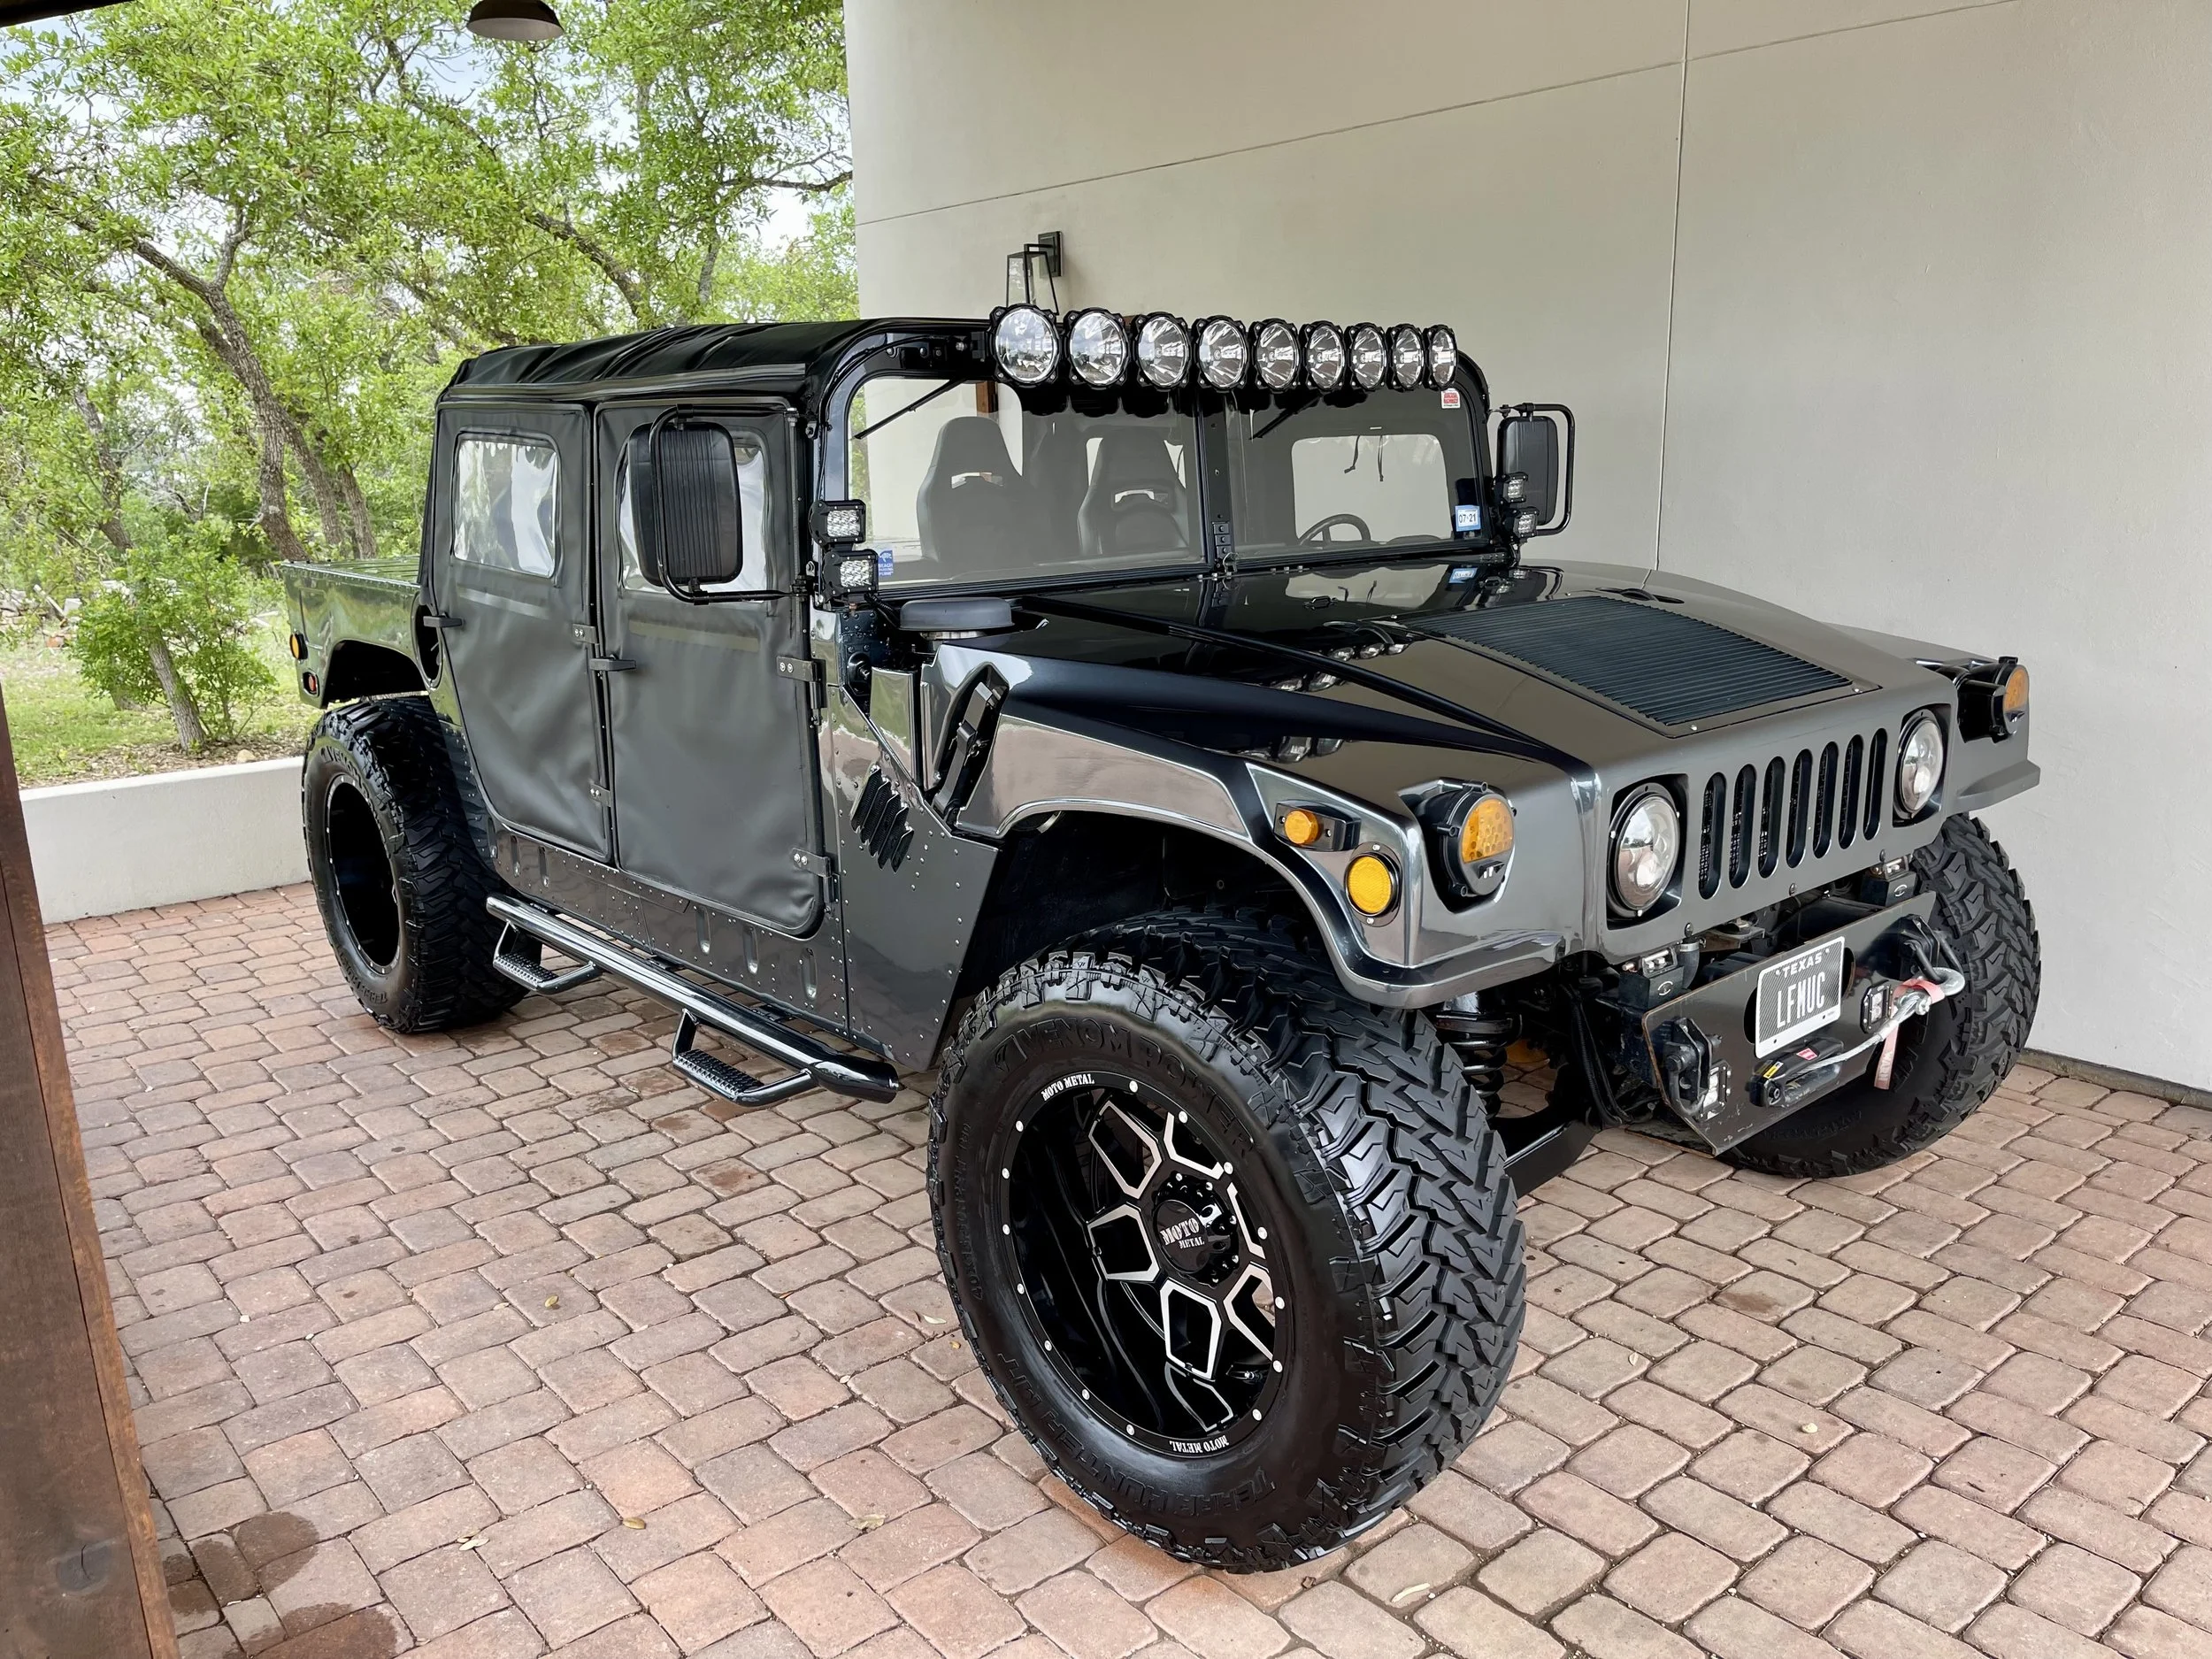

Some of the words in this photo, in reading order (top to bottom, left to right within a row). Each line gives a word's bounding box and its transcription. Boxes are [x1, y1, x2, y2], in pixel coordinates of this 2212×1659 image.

[1782, 953, 1823, 979] TEXAS
[1018, 1018, 1133, 1059] VENOM
[1041, 1080, 1064, 1101] MOTO
[1064, 1073, 1095, 1088] METAL
[1160, 1217, 1200, 1246] MOTO
[1179, 1236, 1205, 1249] METAL
[1169, 1440, 1203, 1453] METAL
[1203, 1435, 1229, 1452] MOTO
